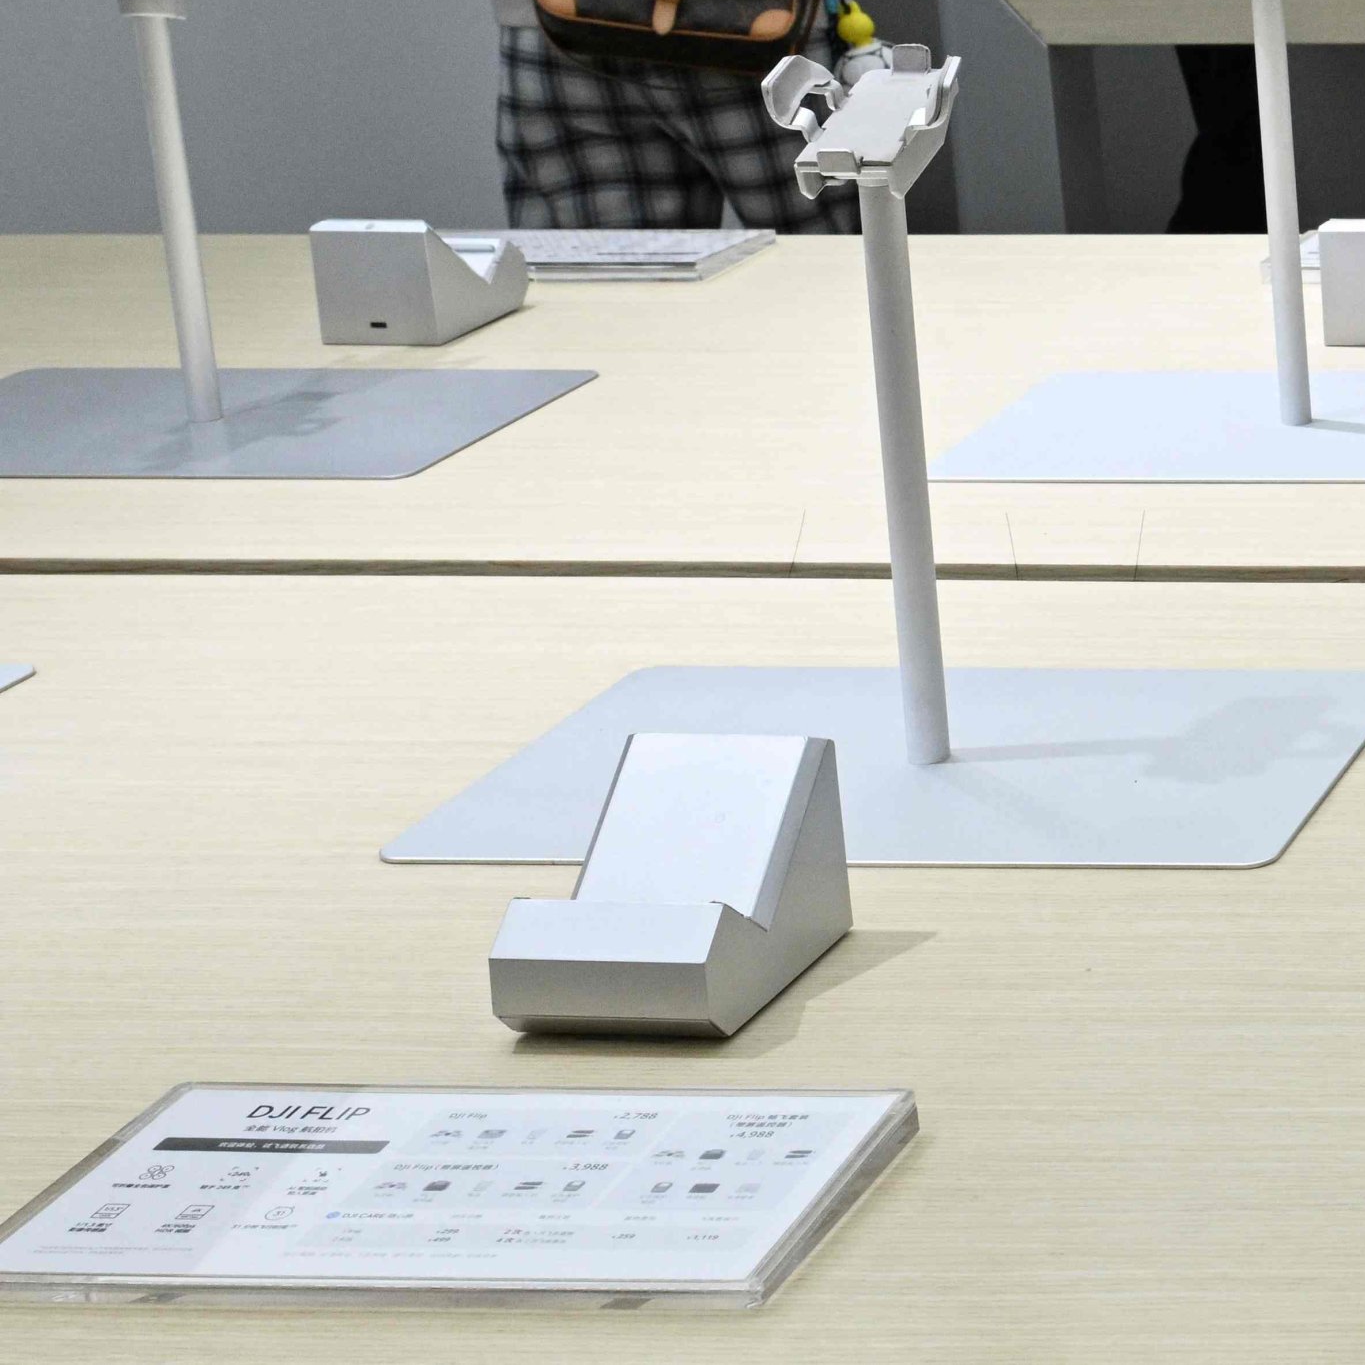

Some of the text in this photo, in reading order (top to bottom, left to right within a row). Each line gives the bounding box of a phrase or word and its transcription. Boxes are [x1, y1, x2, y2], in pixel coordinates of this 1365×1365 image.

[246, 1104, 371, 1121] DJI FLIP
[272, 1125, 298, 1133] Vlog
